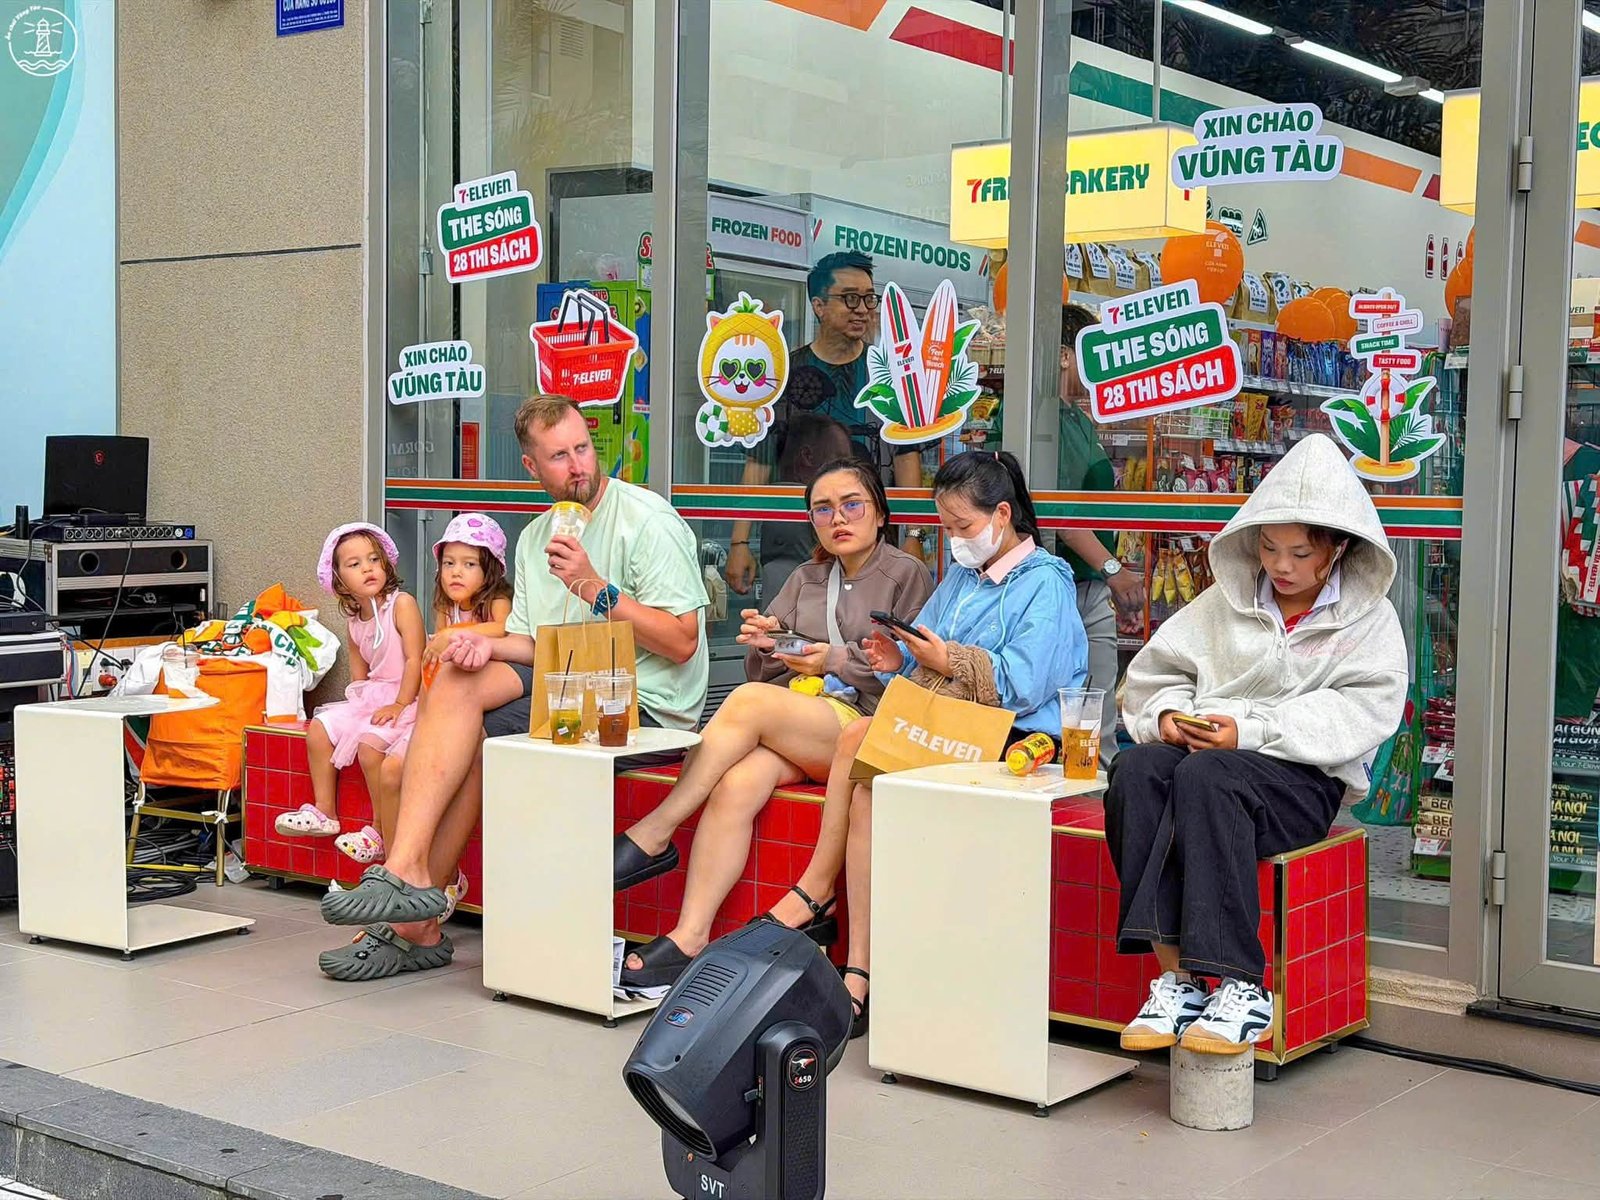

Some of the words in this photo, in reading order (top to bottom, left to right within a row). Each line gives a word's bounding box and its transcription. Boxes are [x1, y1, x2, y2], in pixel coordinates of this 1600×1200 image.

[1203, 115, 1243, 139] XIN
[1247, 108, 1313, 133] CHÀO
[1178, 145, 1265, 181] VŨNG
[1271, 139, 1337, 173] TÀU
[448, 214, 483, 241] THE
[484, 206, 523, 232] SÓNG
[711, 216, 768, 241] FROZEN
[771, 227, 801, 248] FOOD
[453, 252, 468, 272] 28
[468, 247, 489, 269] THI
[490, 236, 531, 265] SÁCH
[834, 225, 908, 259] FROZEN
[911, 242, 971, 272] FOODS
[404, 349, 427, 368] XIN
[429, 343, 467, 364] CHÀO
[1092, 336, 1147, 372] THE
[1149, 321, 1210, 357] SÓNG
[1361, 341, 1380, 350] SNACK
[1381, 339, 1394, 347] TIME
[391, 372, 442, 399] VŨNG
[445, 367, 482, 392] TÀU
[1103, 384, 1125, 410] 28
[1127, 375, 1158, 404] THI
[1159, 358, 1225, 397] SÁCH
[700, 1174, 725, 1199] SVT
